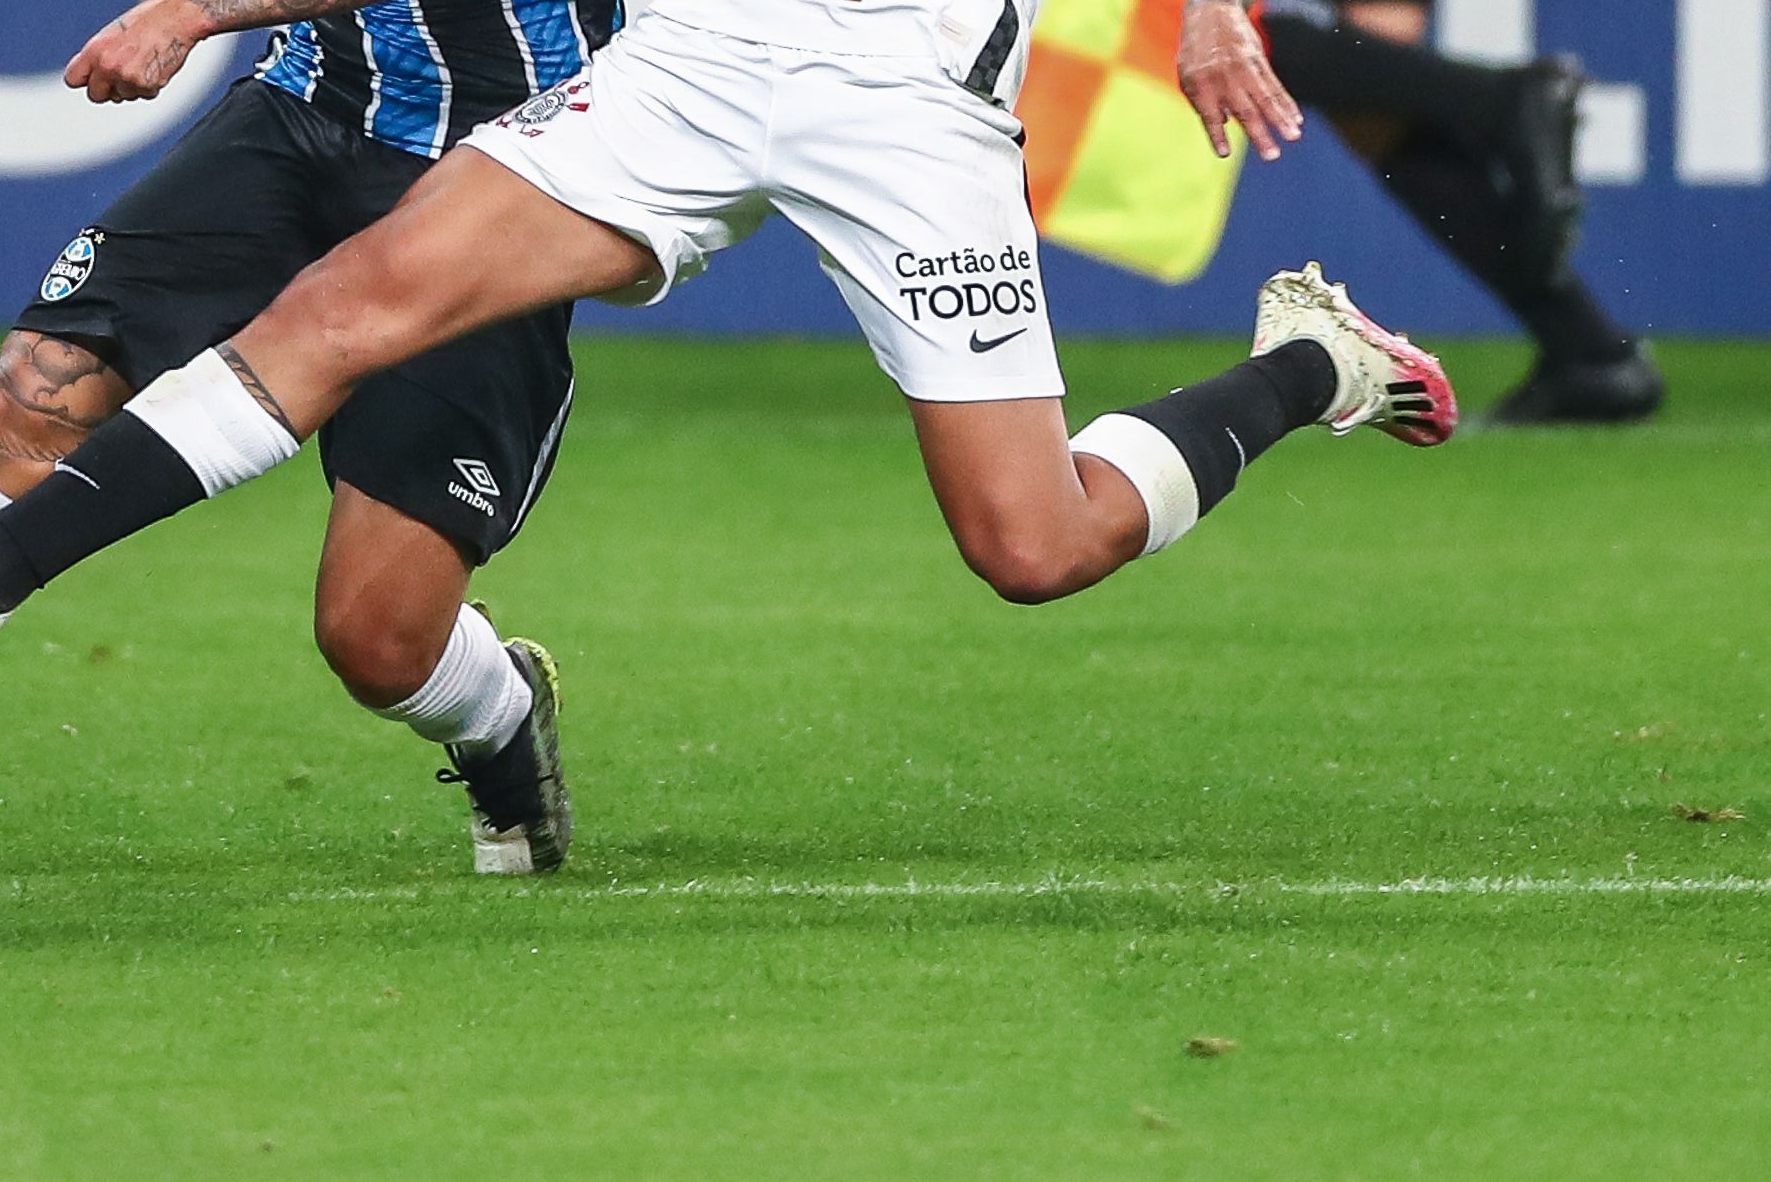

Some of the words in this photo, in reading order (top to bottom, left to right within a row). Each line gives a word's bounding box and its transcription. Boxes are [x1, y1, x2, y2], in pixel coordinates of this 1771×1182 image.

[895, 247, 996, 277] Cartão
[999, 244, 1031, 271] de
[899, 278, 1037, 321] TODOS
[447, 481, 495, 517] umbro
